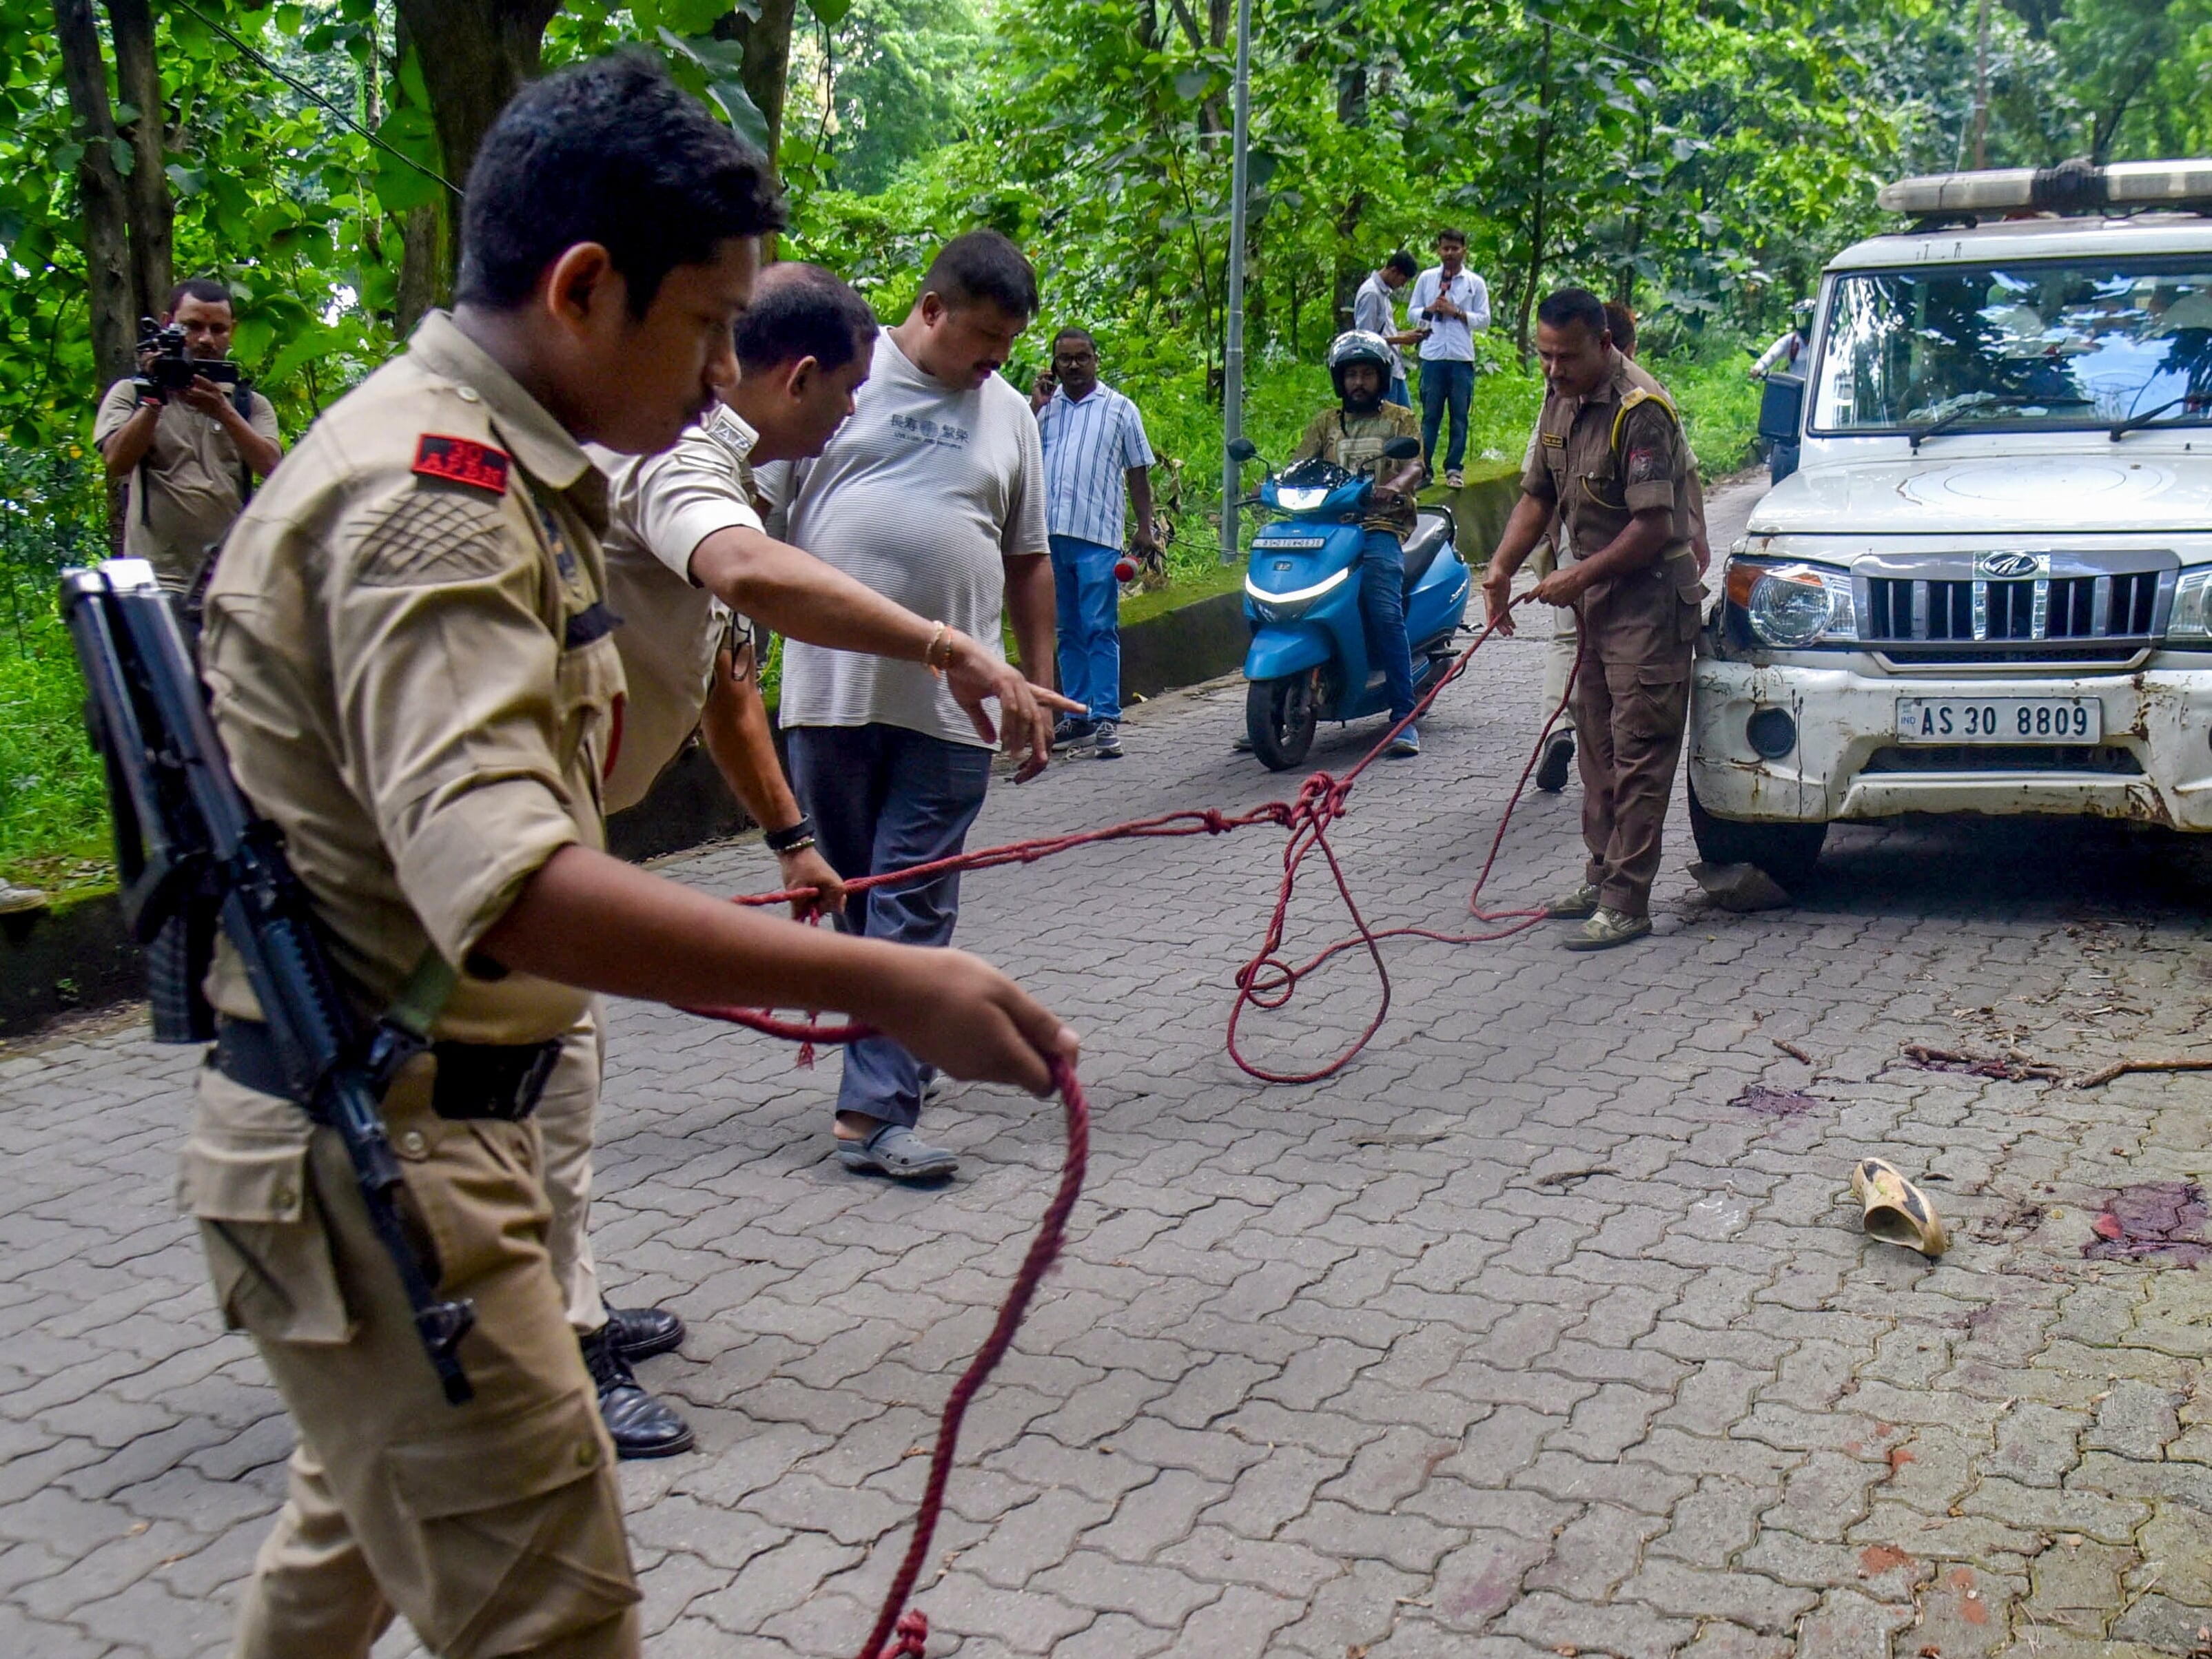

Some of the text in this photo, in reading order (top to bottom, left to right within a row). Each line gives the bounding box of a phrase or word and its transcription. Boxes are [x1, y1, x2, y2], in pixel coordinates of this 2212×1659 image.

[1901, 716, 1916, 725] IND
[1921, 707, 2088, 736] AS 30 8809
